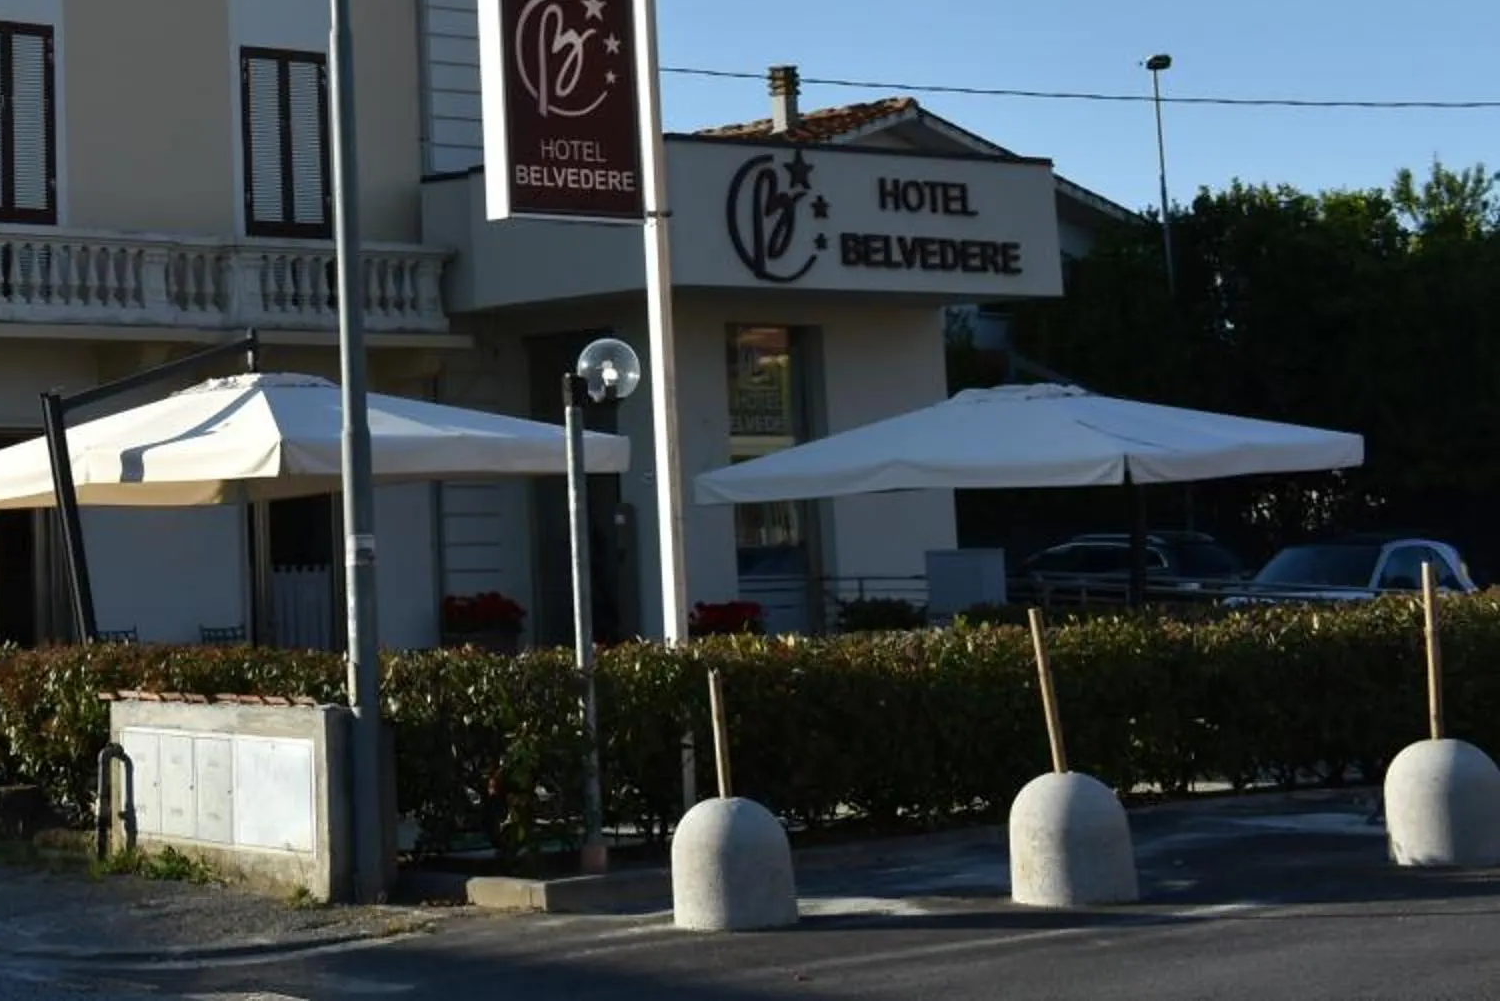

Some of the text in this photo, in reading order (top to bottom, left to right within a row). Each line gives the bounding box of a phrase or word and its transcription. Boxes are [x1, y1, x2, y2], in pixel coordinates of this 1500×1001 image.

[540, 139, 608, 163] HOTEL
[515, 165, 636, 192] BELVEDERE
[878, 177, 979, 217] HOTEL
[840, 233, 1023, 275] BELVEDERE
